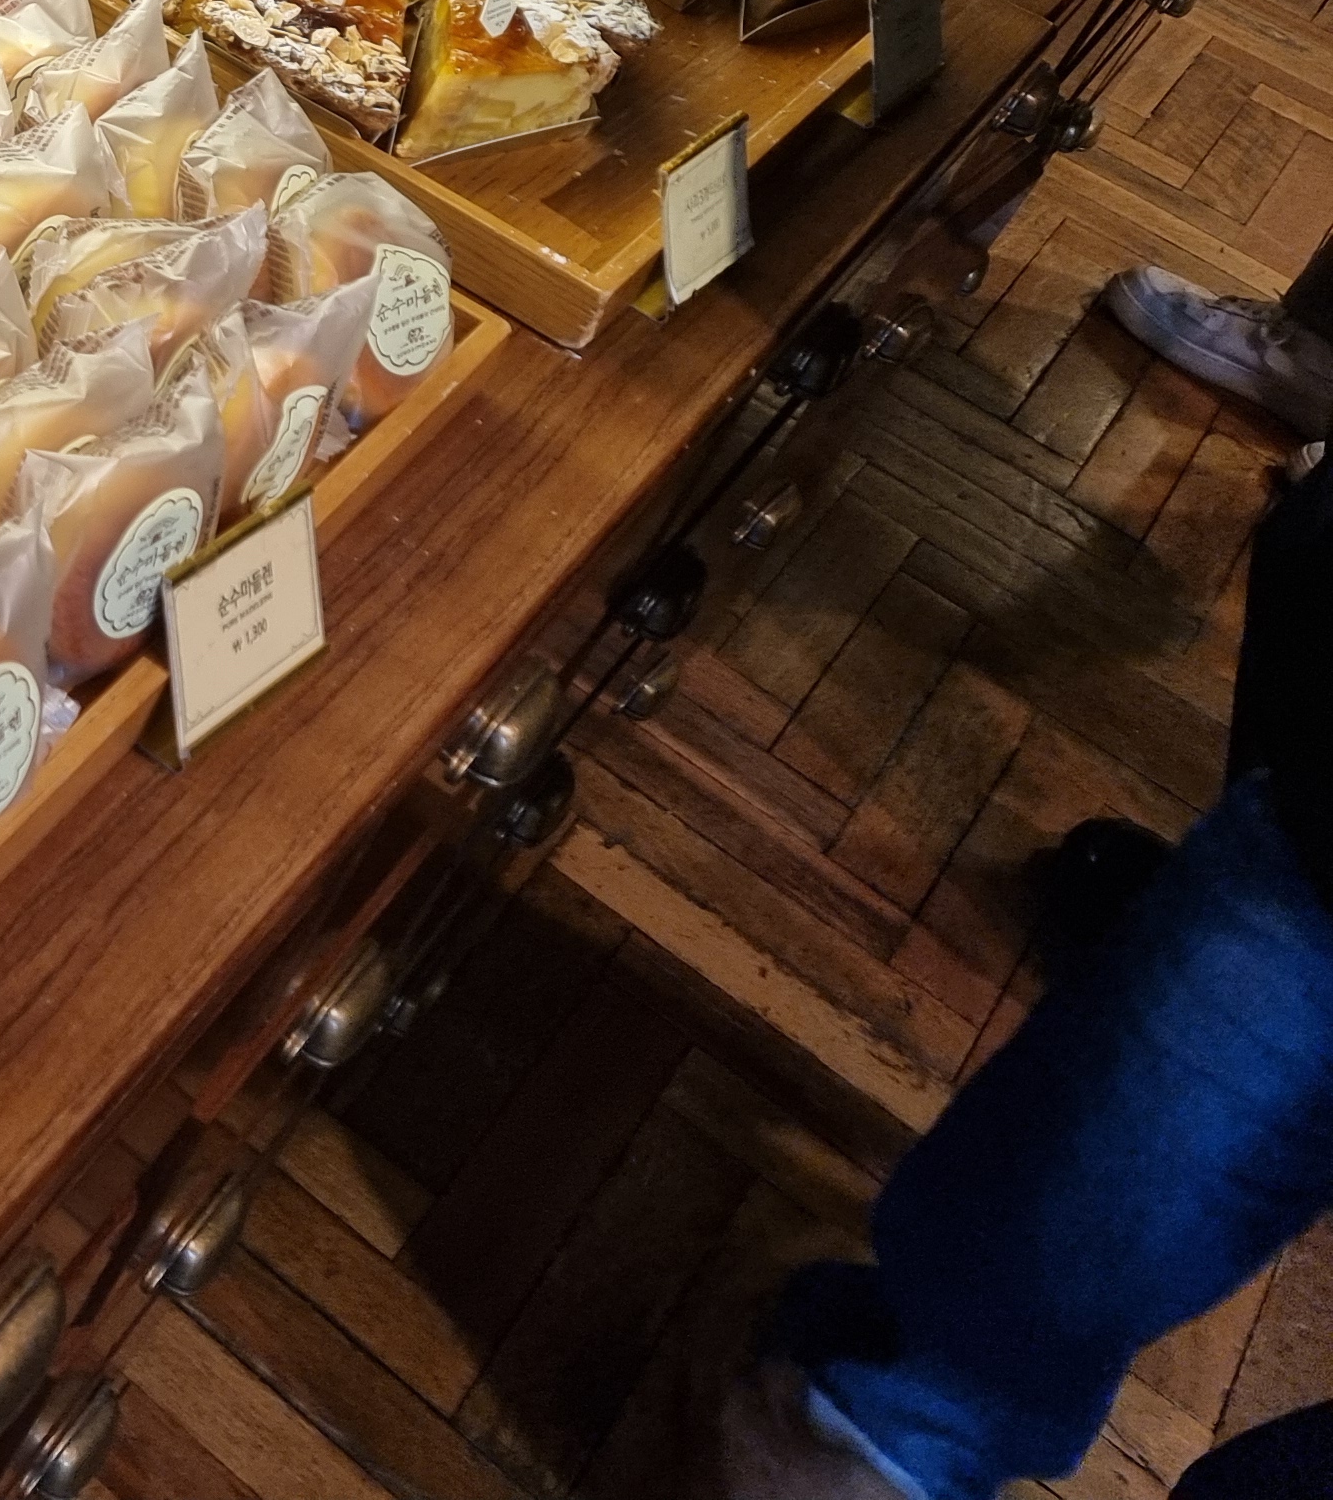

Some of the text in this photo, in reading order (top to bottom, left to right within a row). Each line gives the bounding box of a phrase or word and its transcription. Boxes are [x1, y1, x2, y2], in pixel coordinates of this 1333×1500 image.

[376, 277, 444, 322] 순수마들렌
[218, 561, 274, 618] 순수마들렌
[245, 618, 268, 647] 1,300
